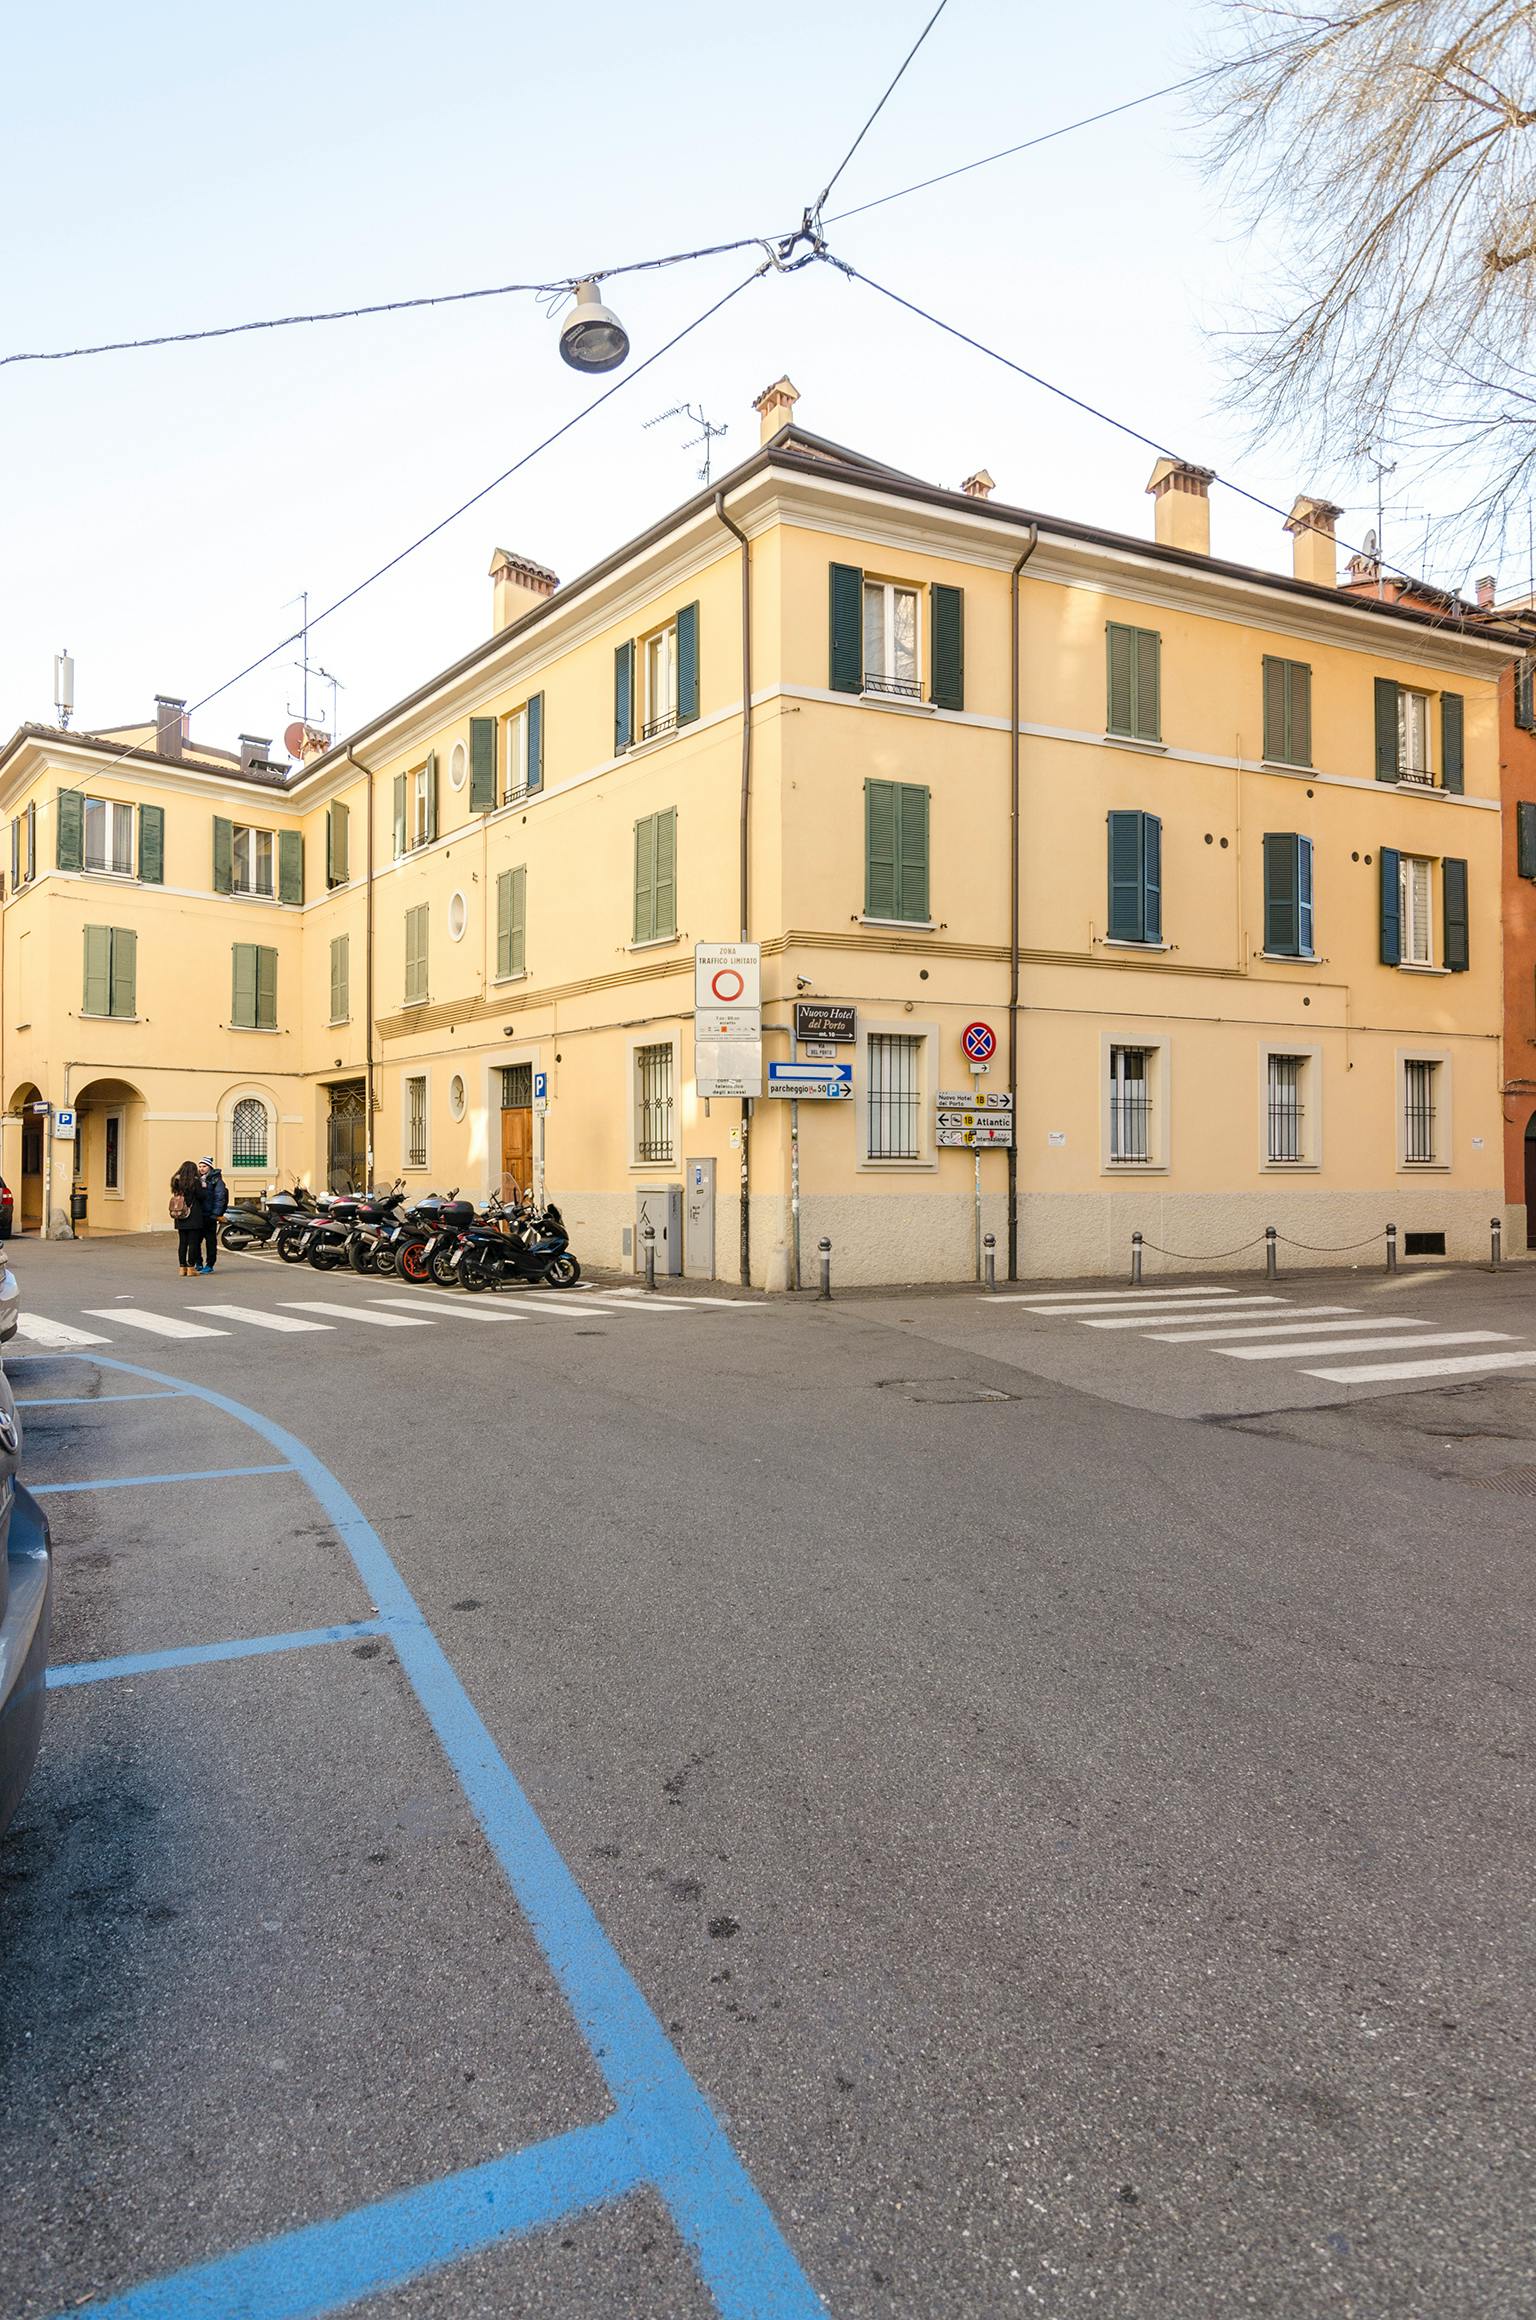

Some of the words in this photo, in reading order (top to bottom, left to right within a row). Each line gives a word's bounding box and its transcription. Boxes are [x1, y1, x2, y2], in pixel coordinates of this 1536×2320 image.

[719, 947, 737, 955] ZONA
[699, 957, 728, 965] TRAFFICO
[730, 957, 758, 965] LIMITATO
[800, 1006, 829, 1018] Nuovo
[830, 1008, 854, 1019] Hotel
[808, 1018, 822, 1029] del
[822, 1019, 846, 1030] Porto
[536, 1076, 544, 1096] P
[770, 1084, 809, 1095] parcheggio
[817, 1084, 827, 1093] 50
[829, 1084, 838, 1096] P
[61, 1114, 71, 1124] P
[976, 1118, 1010, 1126] Atlantic
